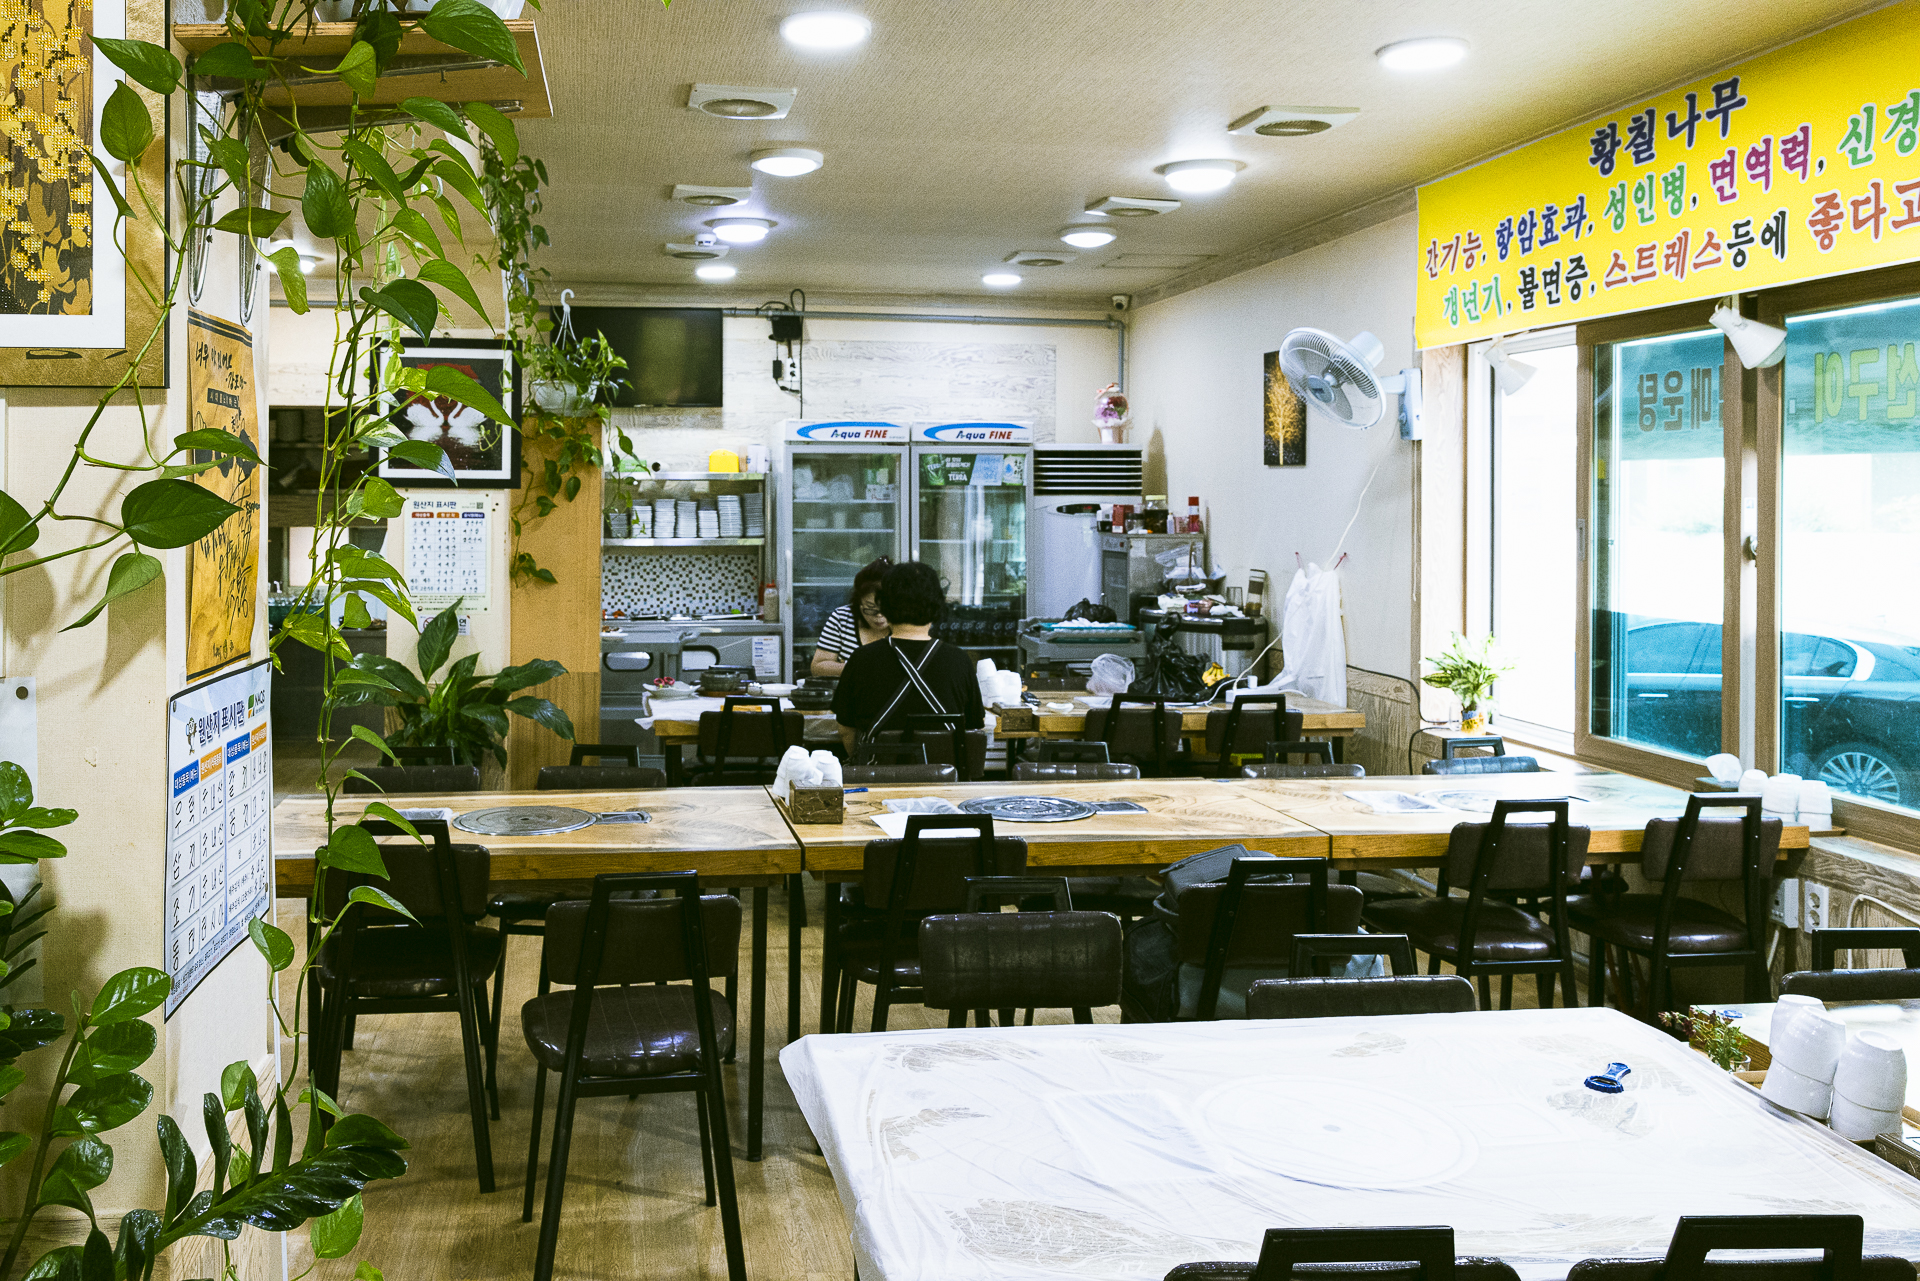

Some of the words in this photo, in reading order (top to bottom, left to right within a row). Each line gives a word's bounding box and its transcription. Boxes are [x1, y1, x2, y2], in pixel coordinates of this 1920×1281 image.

[1590, 77, 1746, 175] 황칠나무
[1496, 195, 1593, 260] 항암효과,
[1604, 165, 1697, 231] 성인병,
[1710, 125, 1824, 202] 면역력,
[1838, 91, 1920, 168] 신경
[1444, 276, 1511, 326] 갱년기,
[1518, 255, 1594, 310] 불면증,
[830, 428, 861, 439] Aqua
[864, 429, 888, 439] FINE
[956, 430, 986, 440] Aqua
[989, 430, 1012, 440] FINE
[413, 501, 434, 510] 원산지
[436, 501, 457, 510] 표시판
[198, 709, 221, 745] 원산지
[221, 700, 244, 730] 표시판
